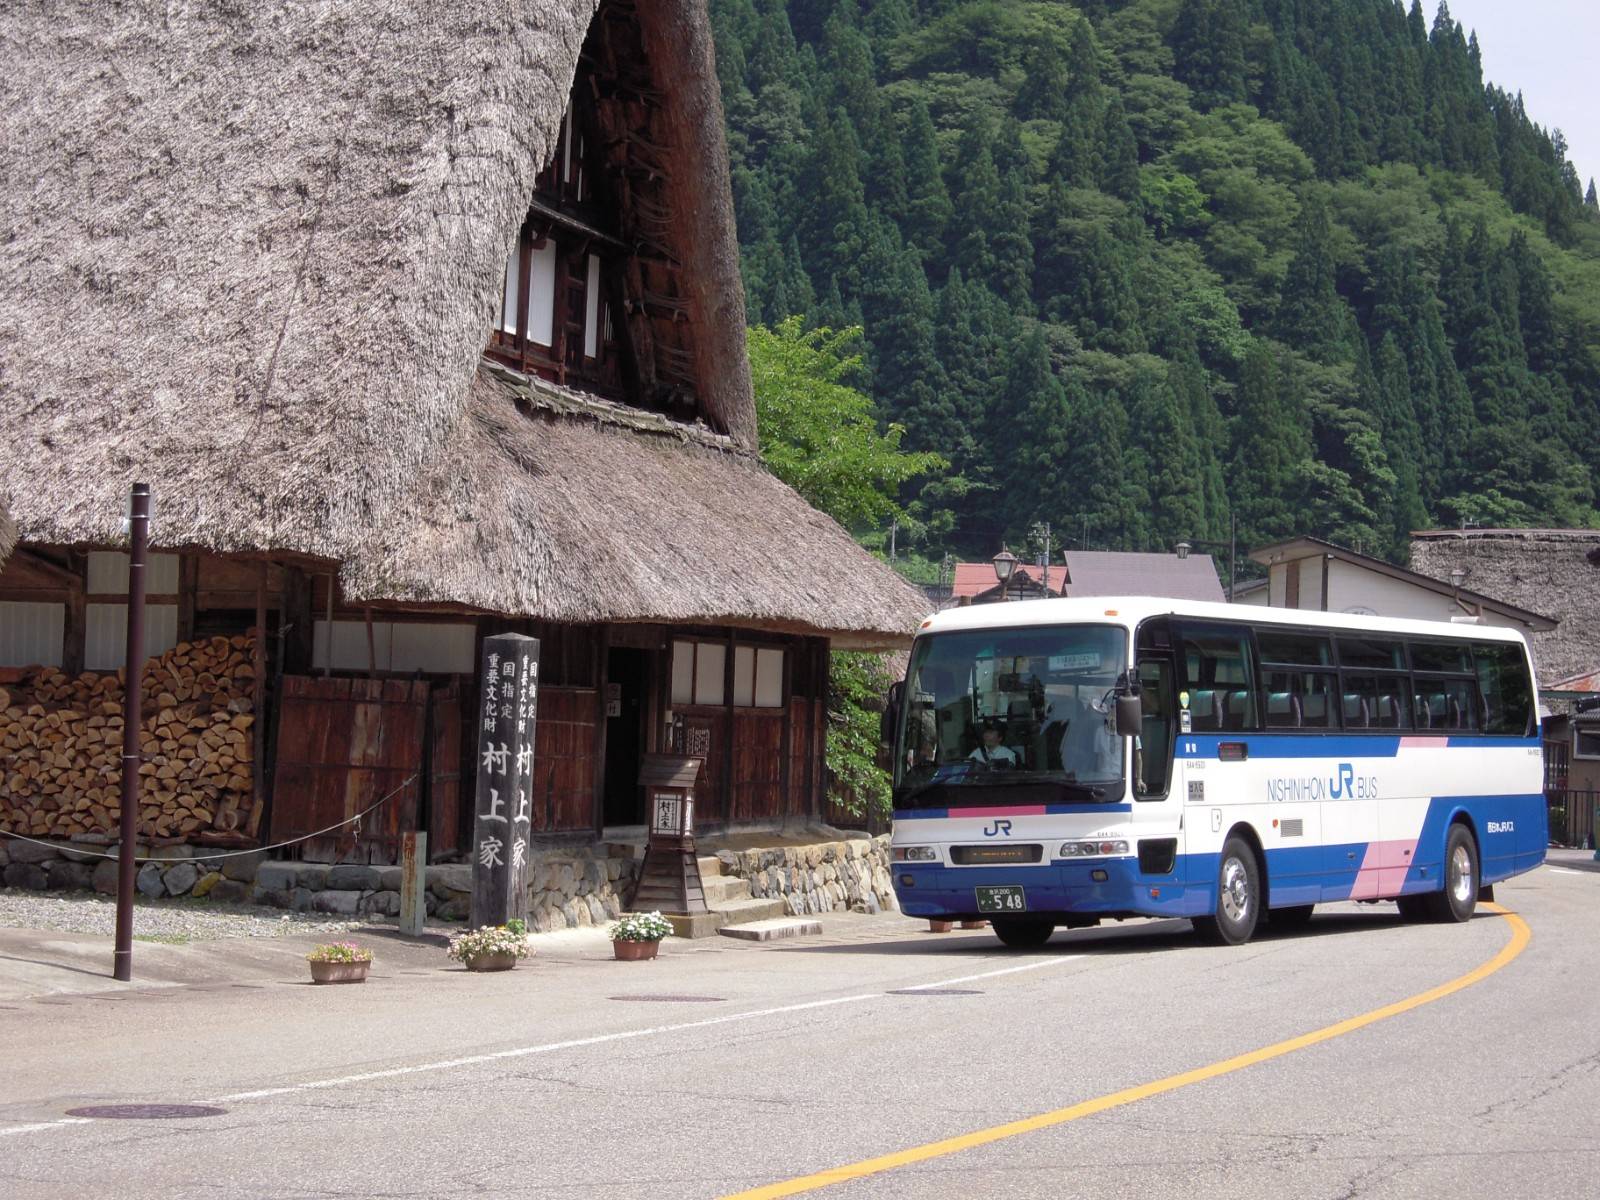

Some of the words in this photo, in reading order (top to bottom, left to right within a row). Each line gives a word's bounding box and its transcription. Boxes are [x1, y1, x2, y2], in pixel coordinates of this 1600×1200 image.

[484, 652, 500, 733] 重要文化財
[502, 661, 516, 719] 国指定
[479, 741, 512, 869] 村上家
[513, 742, 533, 870] 村上家
[1267, 777, 1326, 802] NISHINIHON
[1329, 763, 1354, 799] JR
[1357, 776, 1377, 799] BUS
[983, 820, 1012, 837] JR
